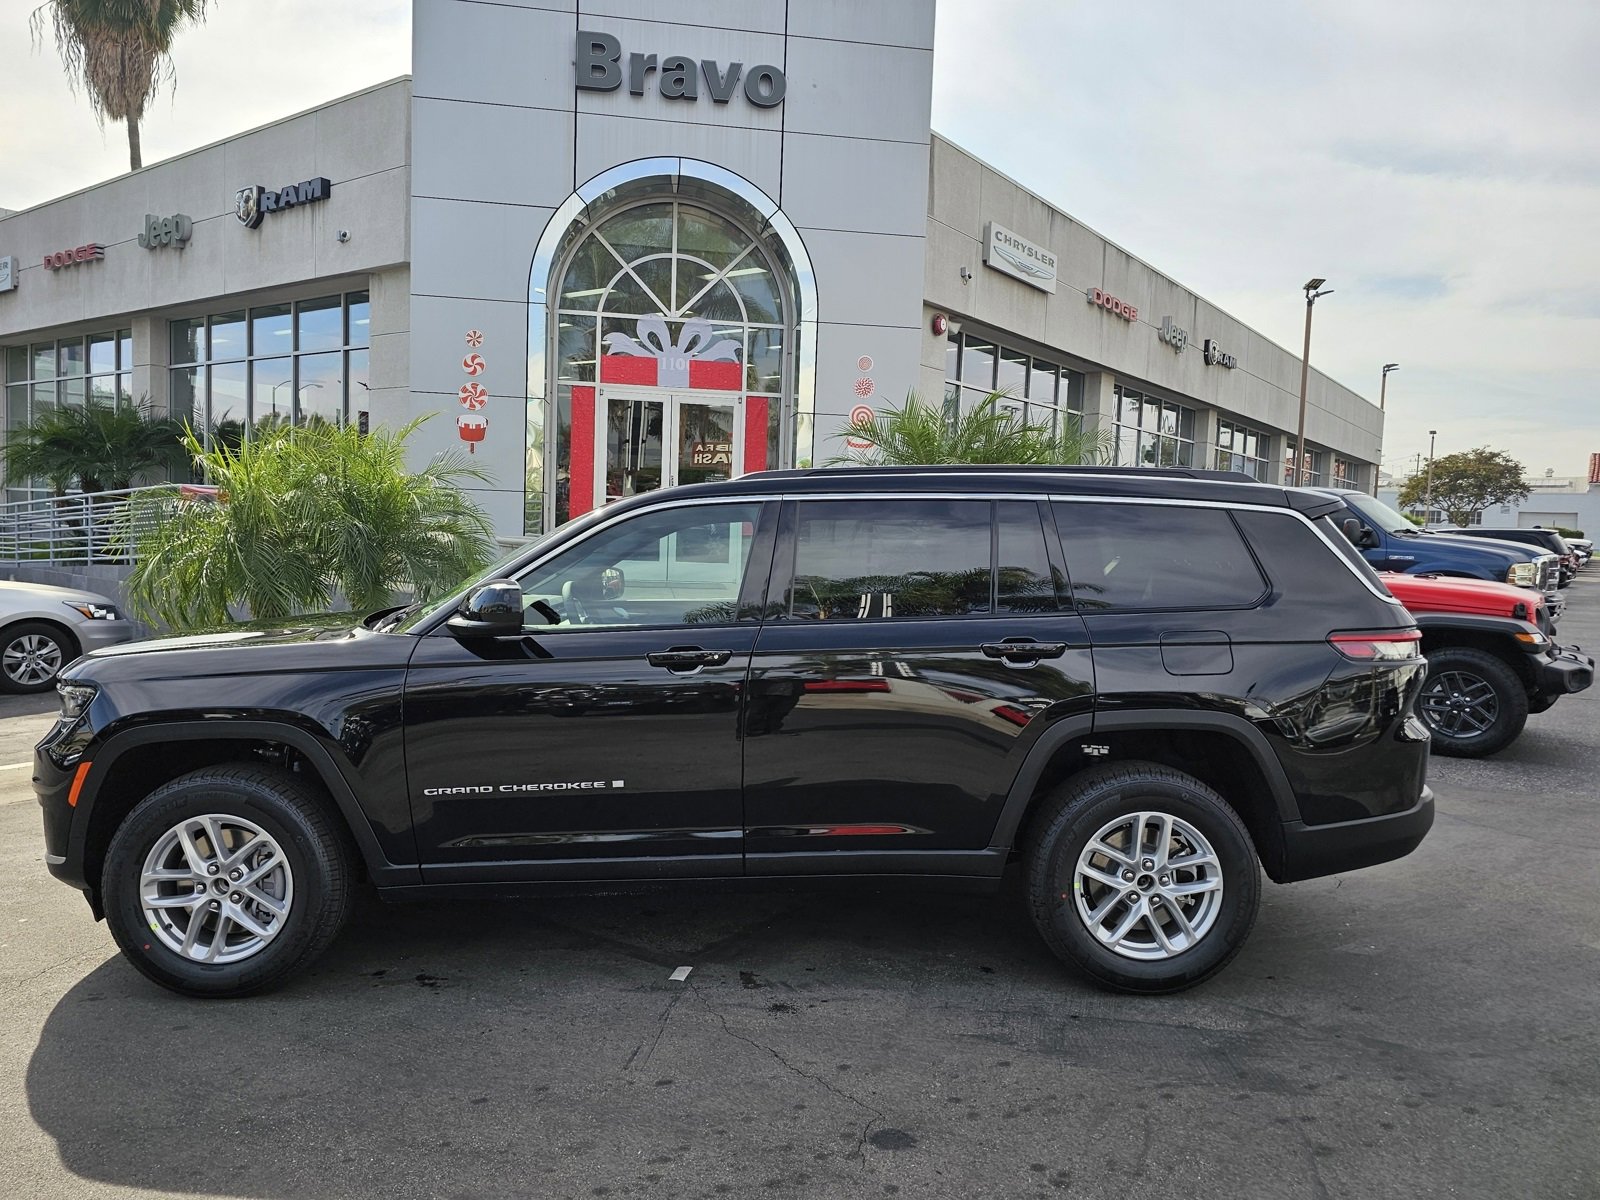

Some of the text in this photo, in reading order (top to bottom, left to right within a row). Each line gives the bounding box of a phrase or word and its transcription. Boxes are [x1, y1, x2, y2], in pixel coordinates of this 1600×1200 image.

[576, 30, 787, 108] Bravo
[260, 177, 329, 213] RAM
[138, 213, 191, 249] Jeep
[44, 243, 102, 270] DODGE
[994, 231, 1055, 268] CHRYSLER
[1090, 287, 1138, 322] DODGE
[1160, 315, 1189, 353] Jeep
[1216, 350, 1237, 369] RAM
[424, 780, 606, 796] GRAND CHEROKEE
